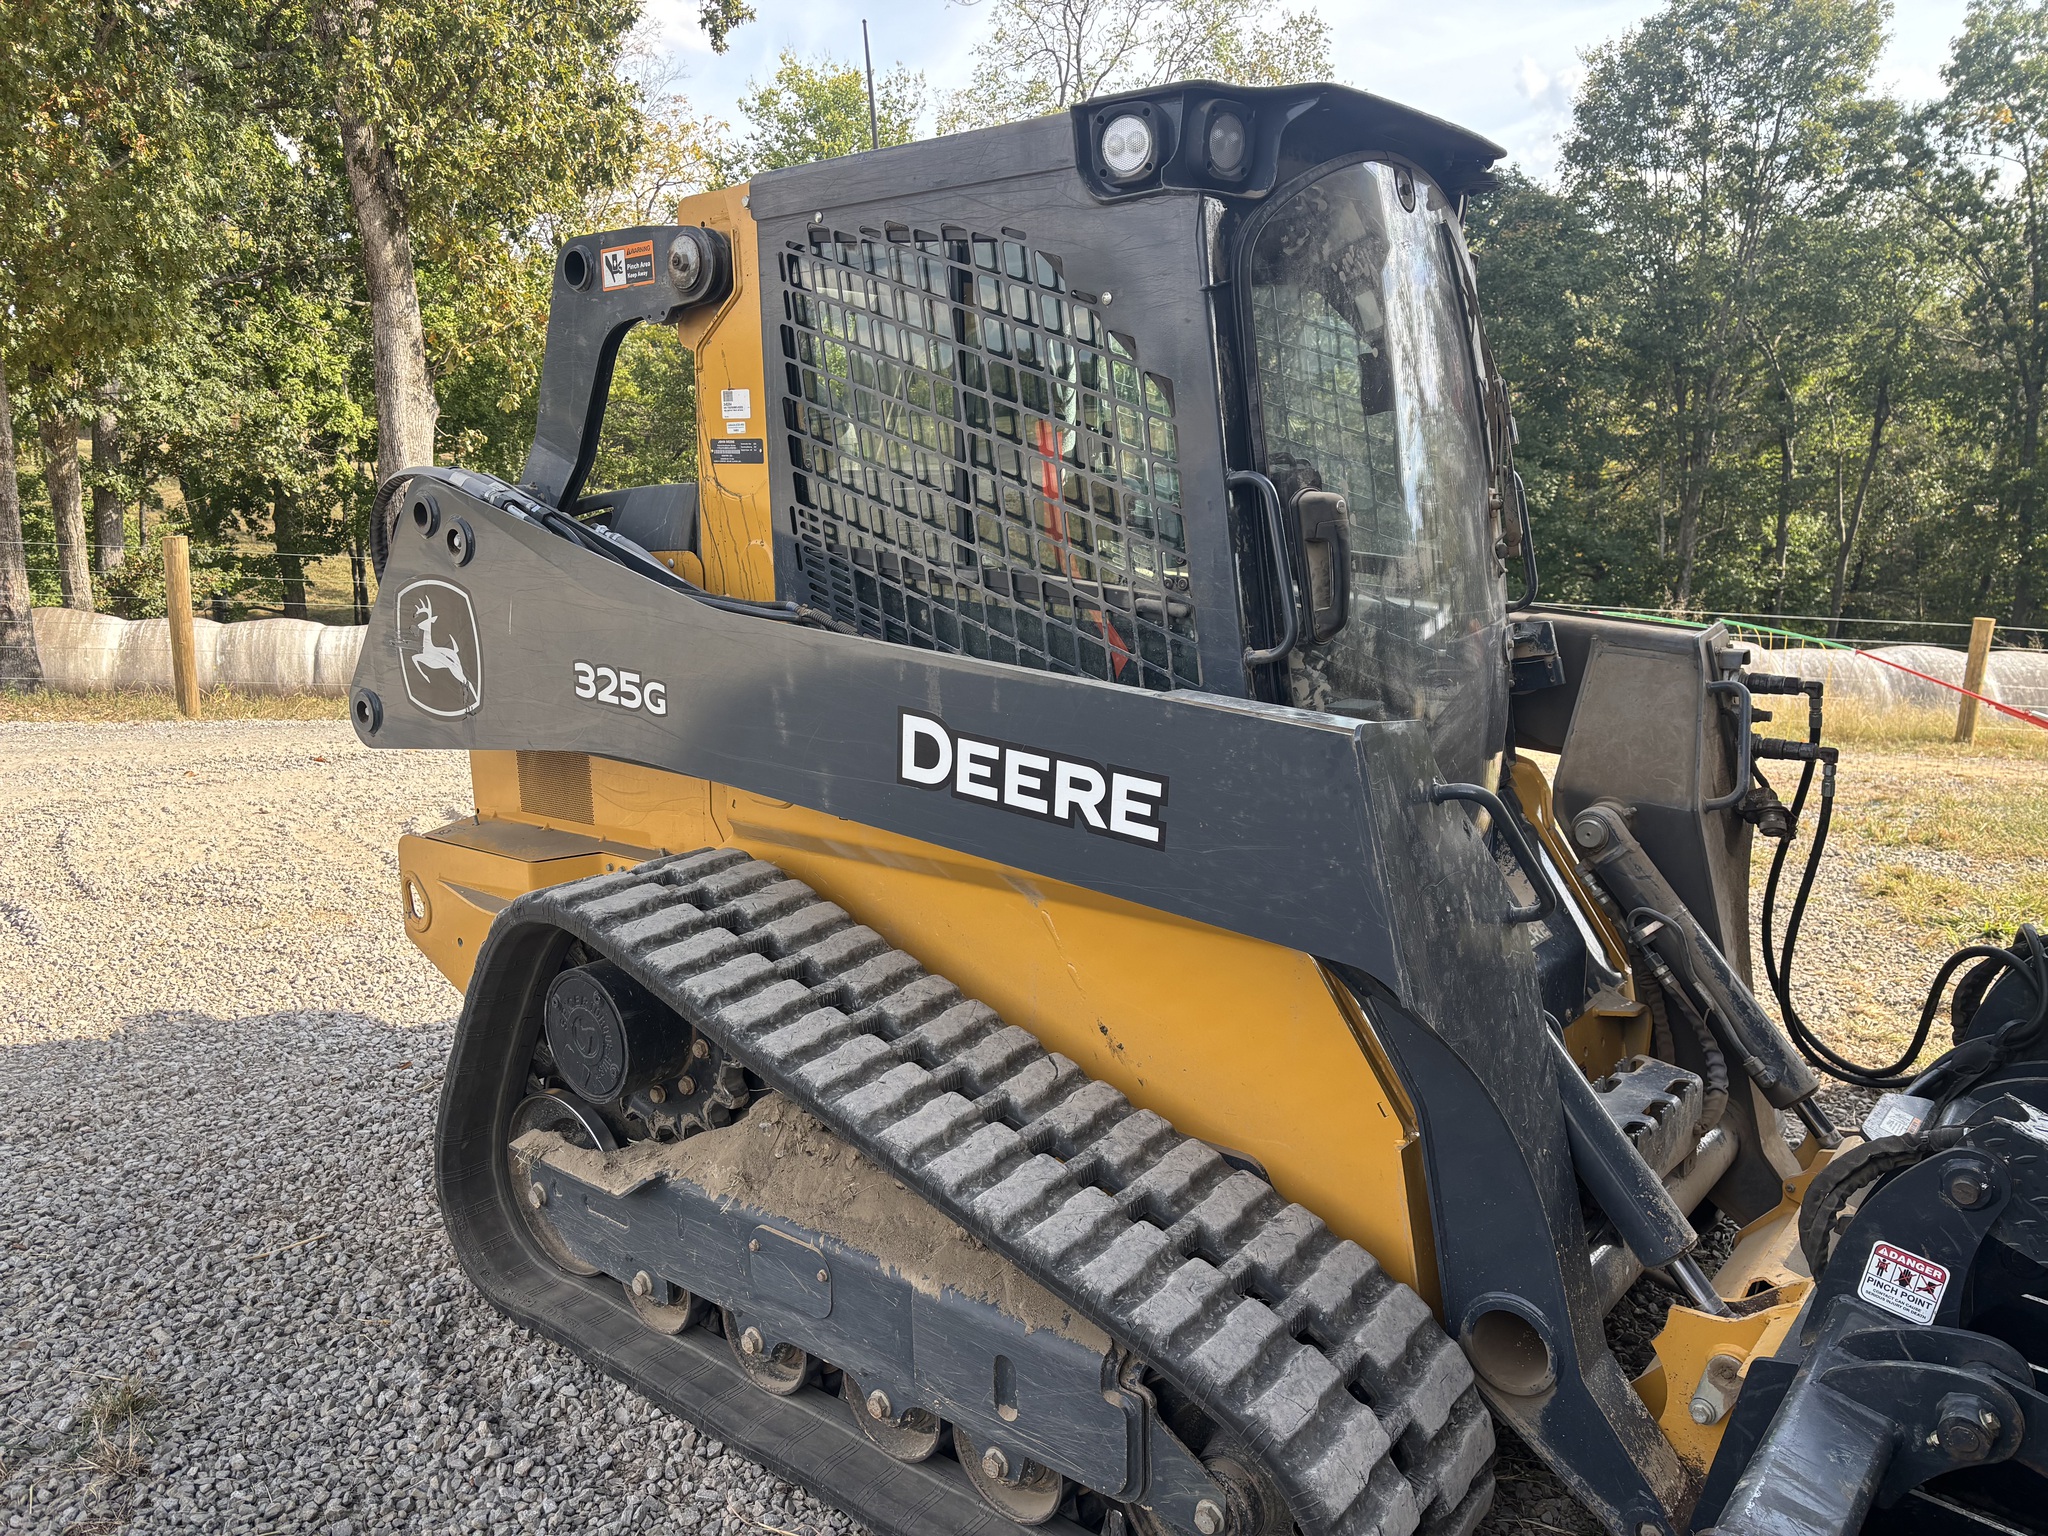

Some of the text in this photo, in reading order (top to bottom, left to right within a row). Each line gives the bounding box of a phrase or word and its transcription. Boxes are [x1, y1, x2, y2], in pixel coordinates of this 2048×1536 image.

[629, 245, 651, 254] WARNING
[574, 662, 667, 715] 325G
[901, 713, 1163, 843] DEERE
[1889, 1250, 1943, 1280] DANGER
[1865, 1289, 1886, 1301] SERIOUS
[1886, 1297, 1902, 1309] INJURY
[1910, 1308, 1926, 1320] DEATH
[1866, 1276, 1932, 1309] PINCH POINT
[1872, 1288, 1921, 1312] CONTACT CAN CAUSE
